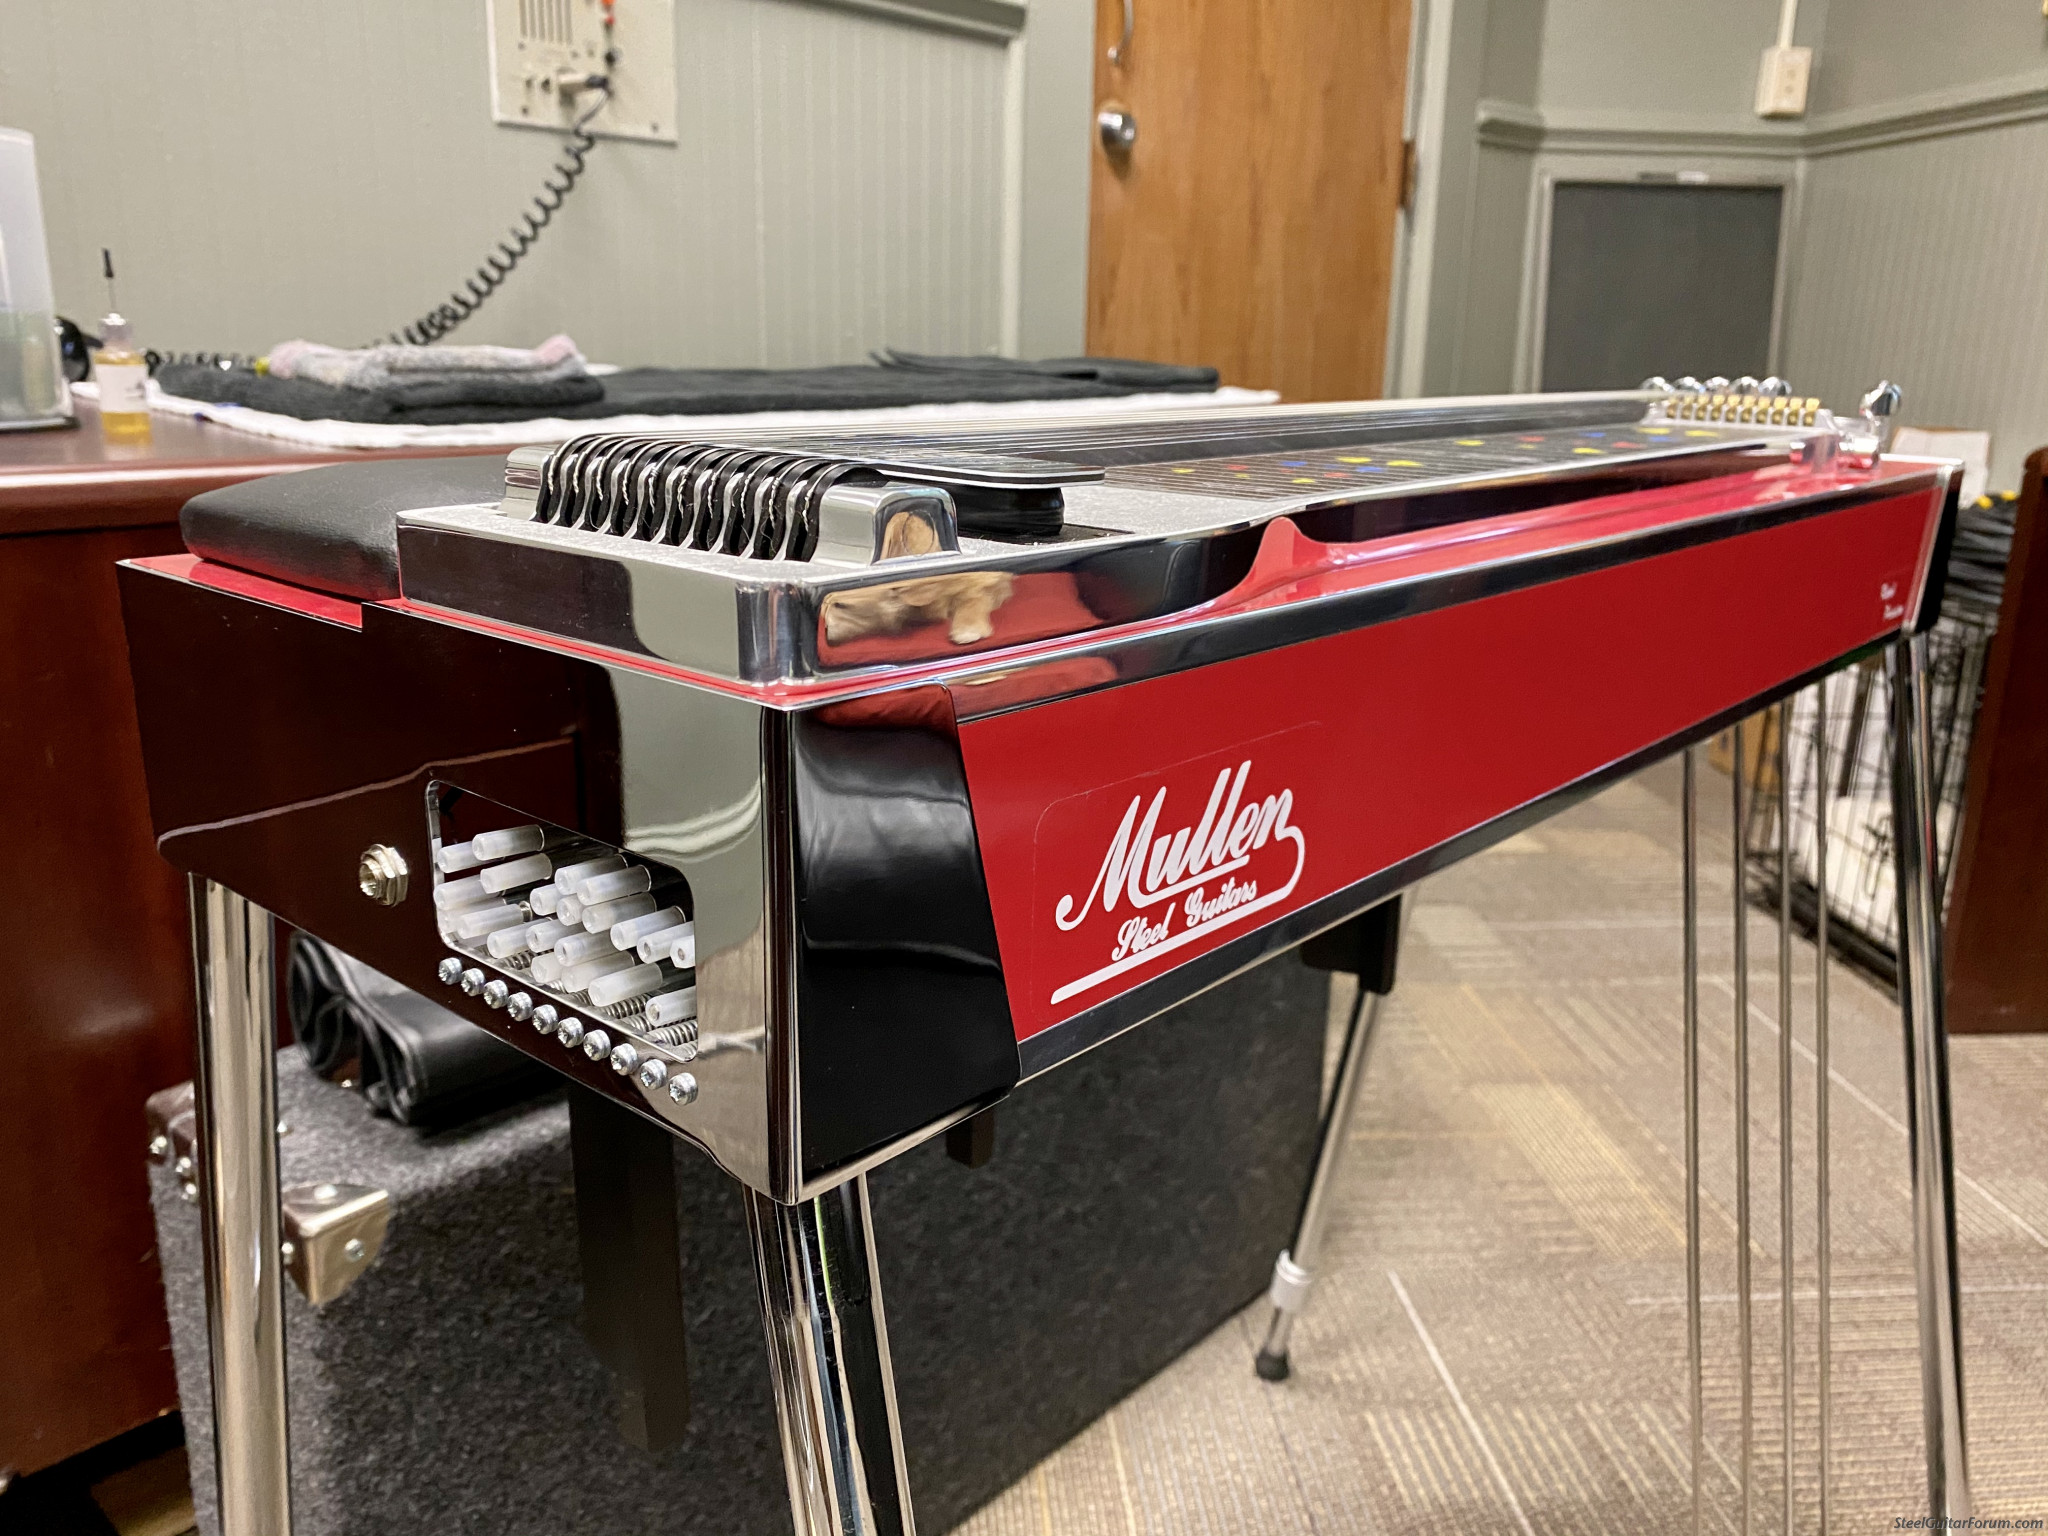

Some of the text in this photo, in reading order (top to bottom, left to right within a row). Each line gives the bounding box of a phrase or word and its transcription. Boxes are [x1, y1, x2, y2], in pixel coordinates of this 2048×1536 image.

[1055, 760, 1304, 931] Mullen
[1111, 877, 1257, 961] Steel Guitars
